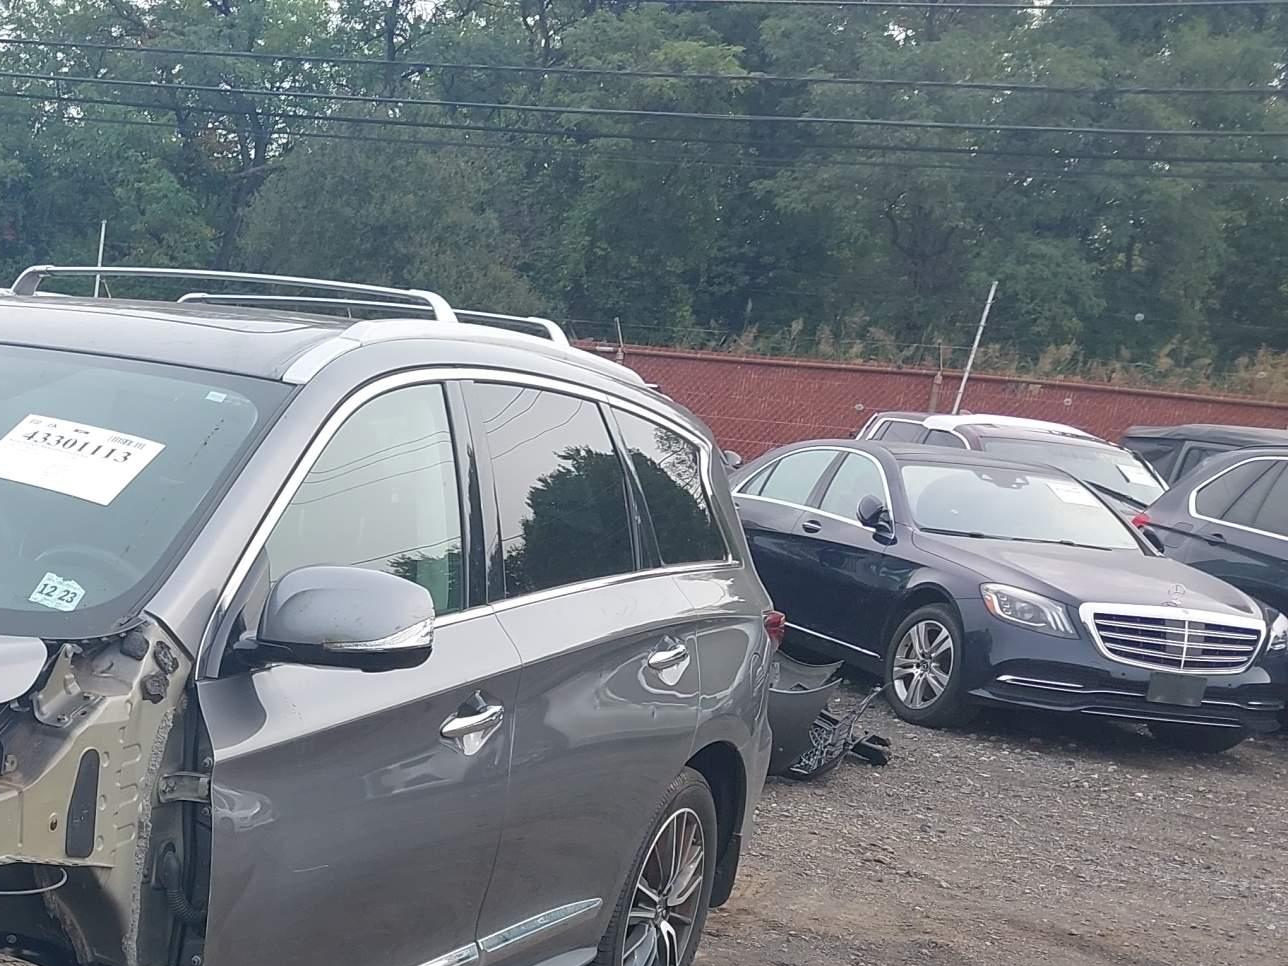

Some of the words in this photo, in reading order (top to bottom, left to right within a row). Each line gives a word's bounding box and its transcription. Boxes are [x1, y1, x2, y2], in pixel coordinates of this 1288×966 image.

[23, 430, 132, 463] 43301113
[37, 583, 58, 597] 12
[57, 589, 77, 603] 23
